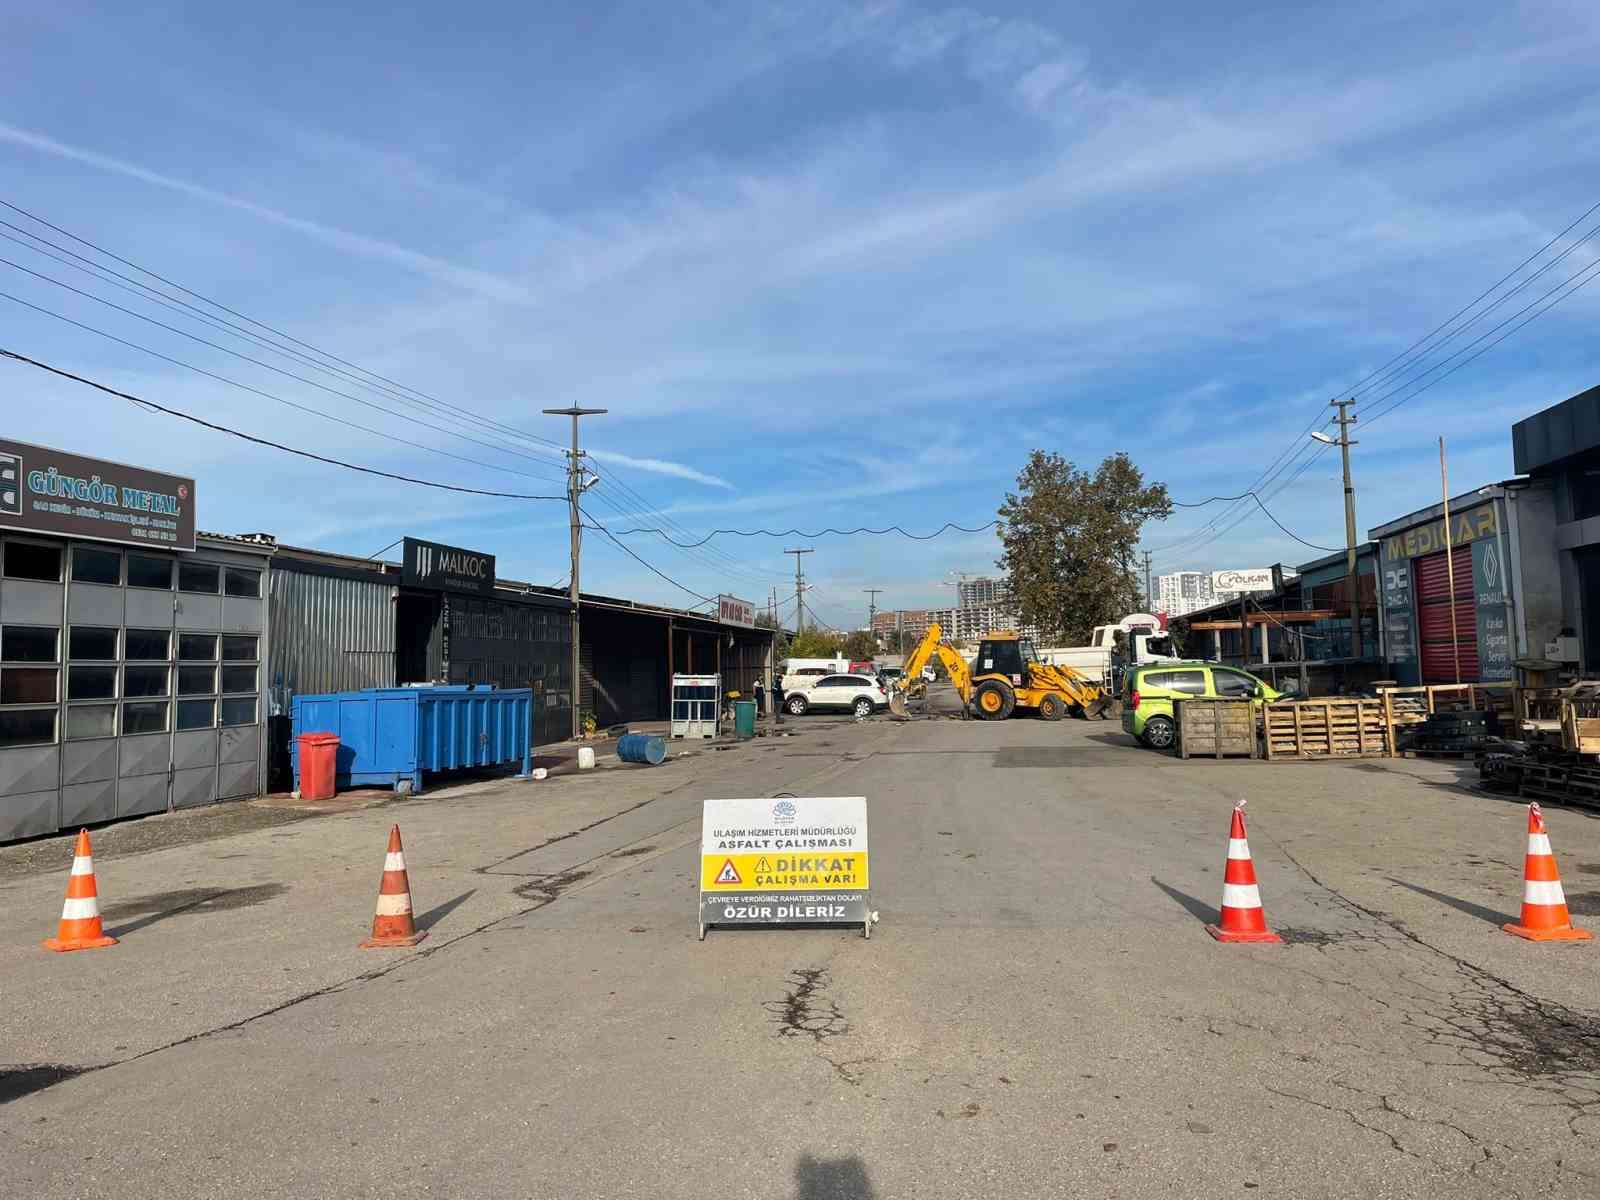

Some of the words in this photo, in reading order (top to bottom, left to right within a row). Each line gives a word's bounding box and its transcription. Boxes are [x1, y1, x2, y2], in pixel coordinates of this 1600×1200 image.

[27, 467, 118, 505] GÜNGÖR
[122, 487, 180, 516] METAL
[714, 829, 746, 838] ULAŞIM
[748, 827, 799, 837] HİZMETLERİ
[801, 825, 857, 836] MÜDÜRLÜĞÜ
[718, 840, 770, 849] ASFALT
[775, 839, 852, 850] ÇALIŞMASI
[776, 856, 856, 872] DİKKAT
[755, 875, 819, 886] ÇALIŞMA
[824, 874, 856, 884] VAR!
[724, 906, 772, 919] ÖZÜR
[776, 904, 846, 918] DİLERİZ
